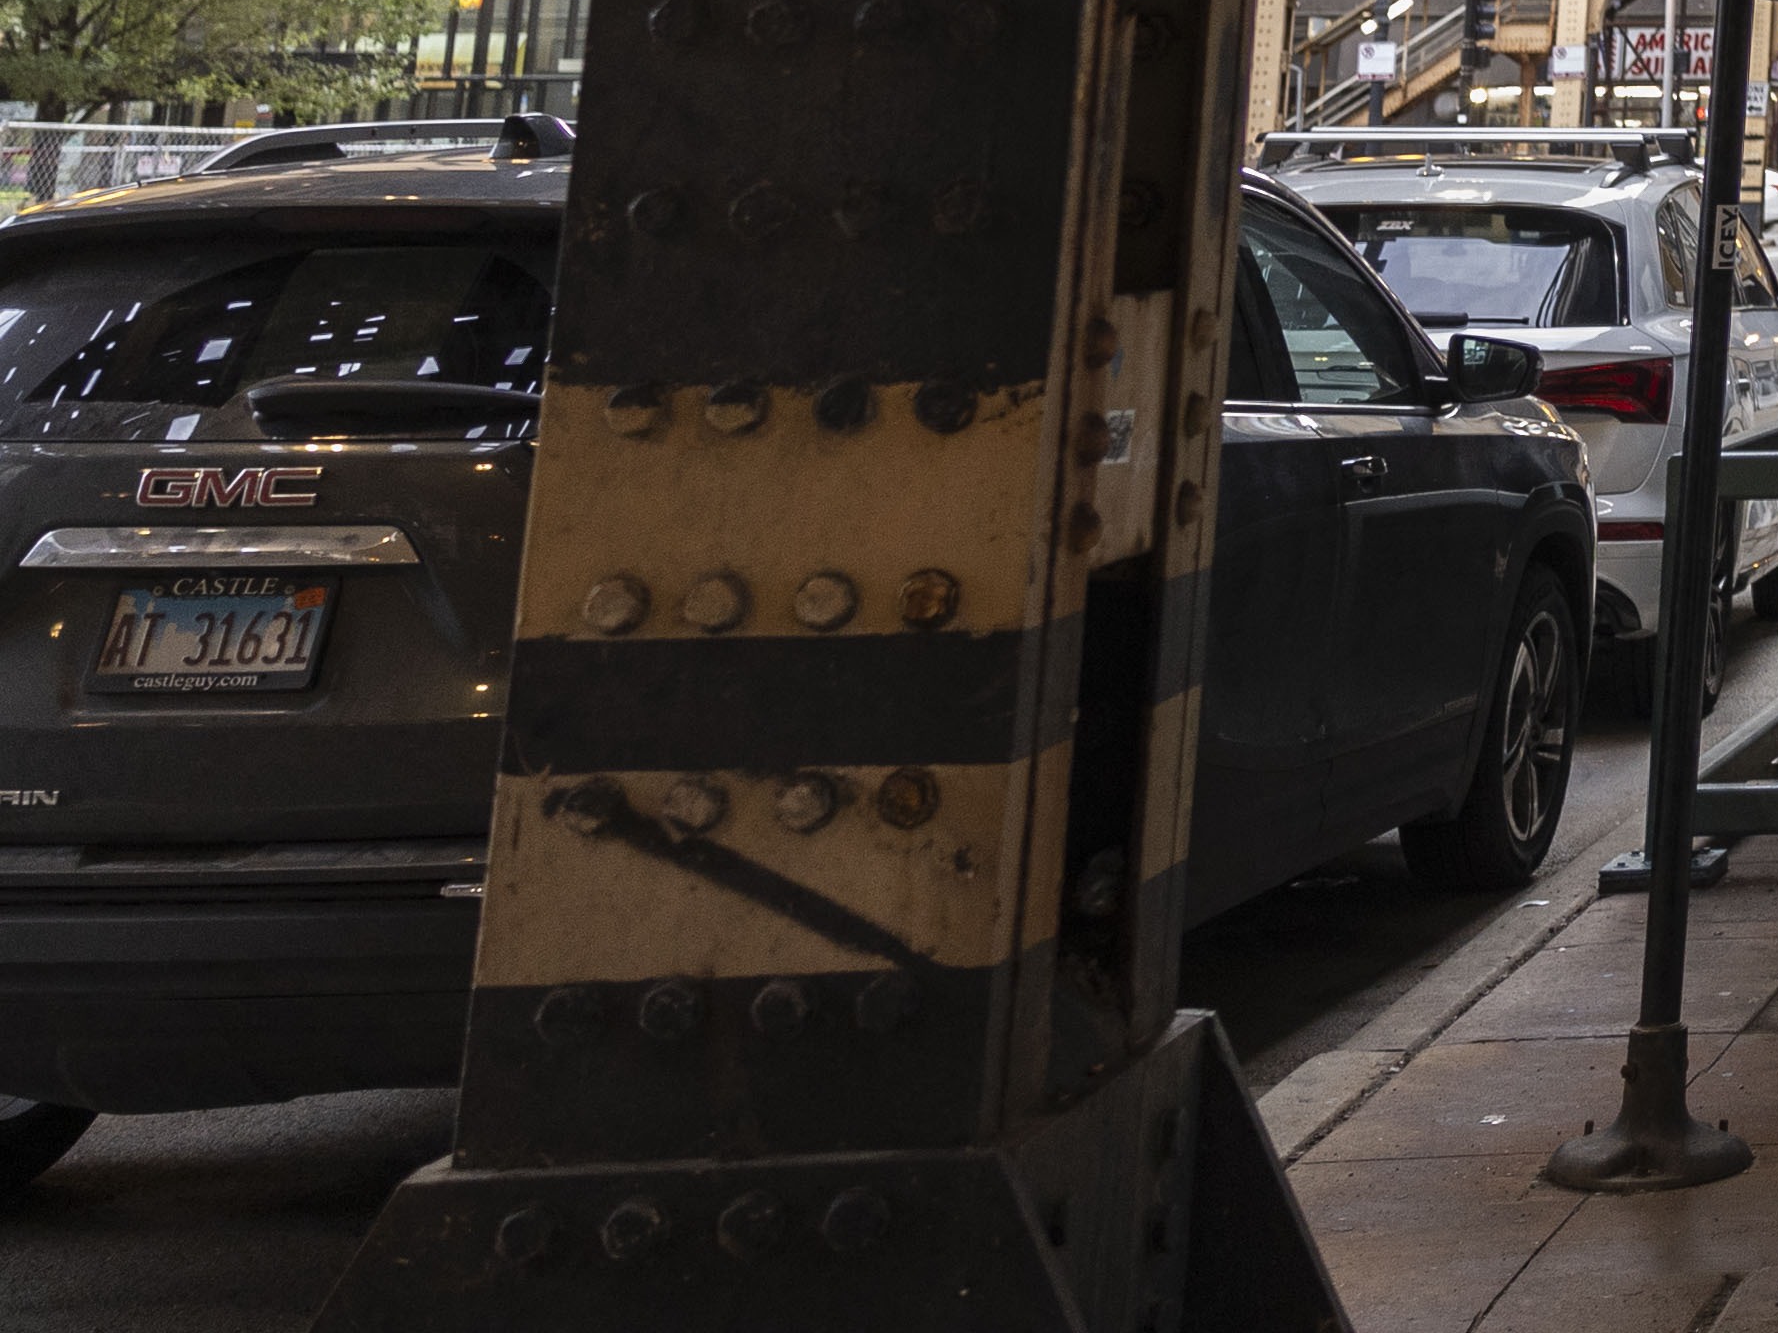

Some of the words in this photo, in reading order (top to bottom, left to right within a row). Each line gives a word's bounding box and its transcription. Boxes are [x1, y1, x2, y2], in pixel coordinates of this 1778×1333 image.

[1718, 207, 1737, 267] ICEY
[136, 466, 324, 508] GMC
[172, 577, 280, 597] CASTLE
[102, 612, 166, 668] AT
[182, 610, 313, 667] 31631
[133, 674, 258, 691] castleguy.com
